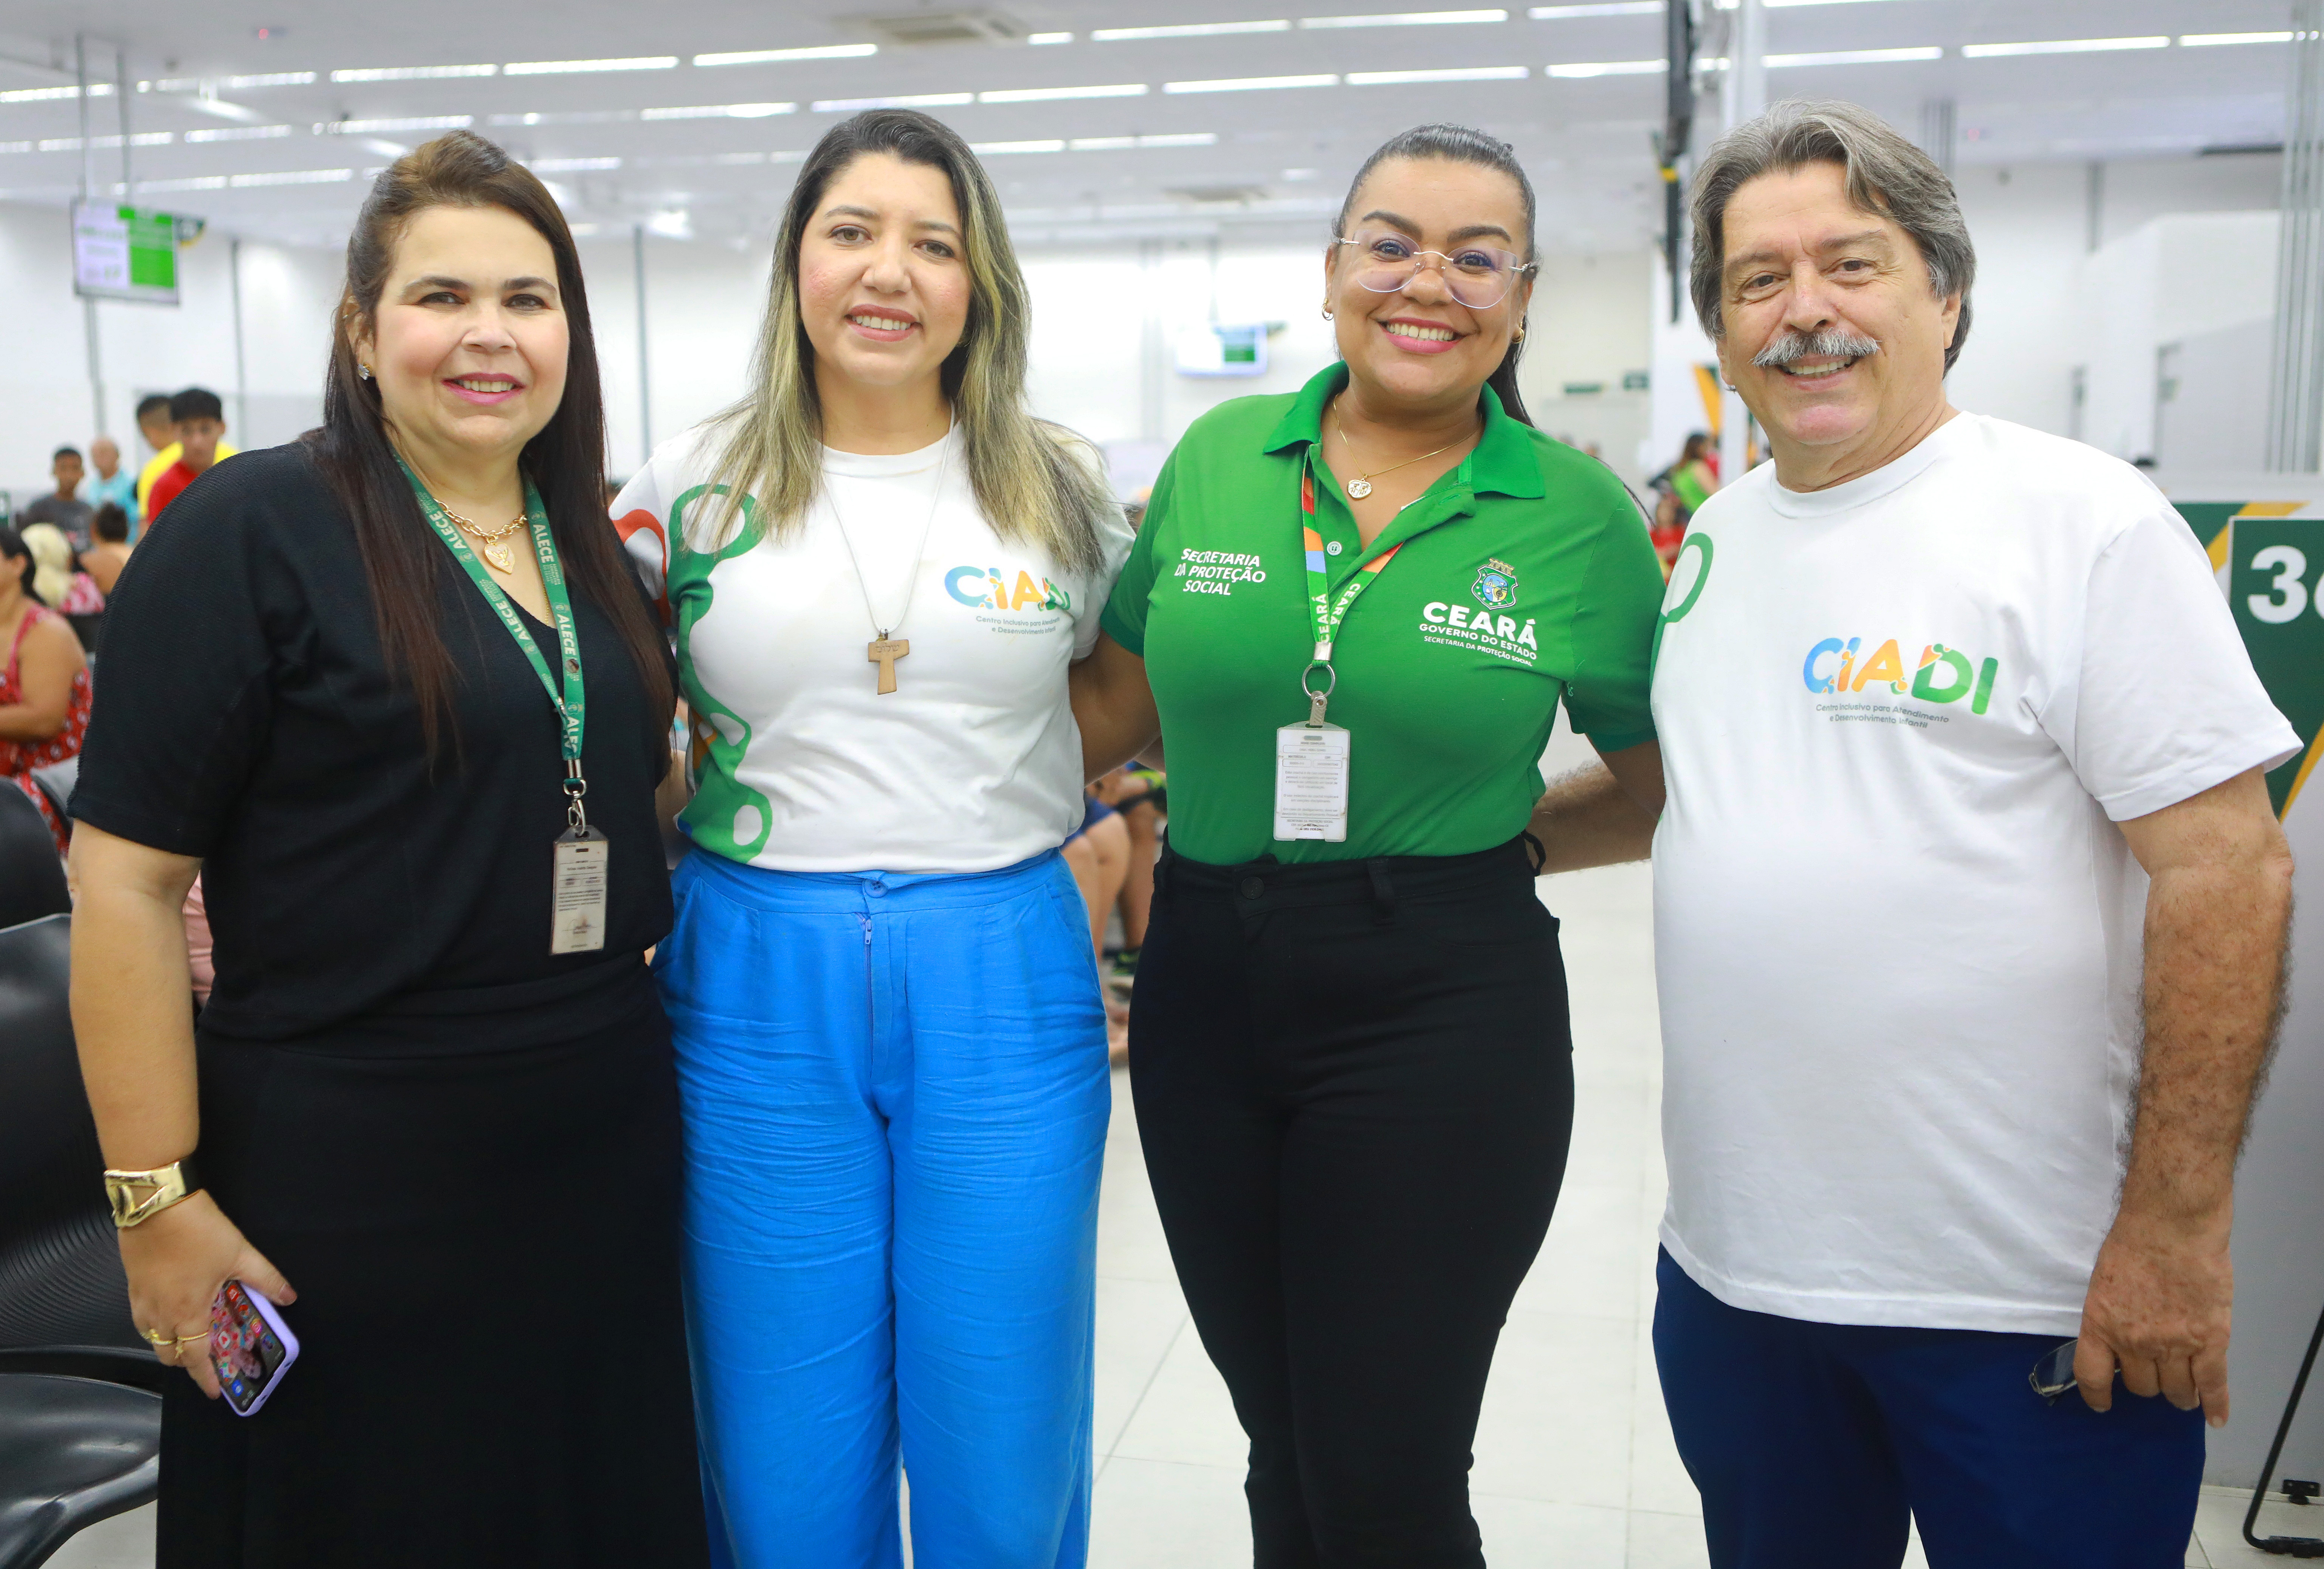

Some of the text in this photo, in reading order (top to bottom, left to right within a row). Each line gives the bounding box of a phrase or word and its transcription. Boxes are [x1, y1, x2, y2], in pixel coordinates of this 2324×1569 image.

[429, 511, 467, 549] ALECE
[533, 525, 555, 563] ALECE
[1174, 563, 1266, 583] DA PROTEÇÃO
[1181, 548, 1260, 567] SECRETARIA
[1183, 580, 1231, 596] SOCIAL
[2248, 545, 2324, 624] 3
[495, 600, 531, 641] ALECE
[976, 616, 1001, 624] Centro
[1311, 594, 1330, 643] CEARÁ
[1330, 583, 1361, 625] CEARÁ
[557, 614, 576, 656] ALECE
[998, 627, 1044, 635] Desenvolvimento
[1419, 624, 1537, 660] GOVERNO DO ESTADO
[1423, 602, 1537, 651] CEARÁ
[1424, 636, 1464, 647] SECRETARIA
[1477, 645, 1511, 659] PROTEÇÃO
[1512, 656, 1532, 667] SOCIAL
[1803, 637, 1998, 715] CIADI
[1835, 714, 1896, 723] Desenvolvimento
[1899, 717, 1928, 728] Infantil
[1892, 706, 1949, 723] Atendimento
